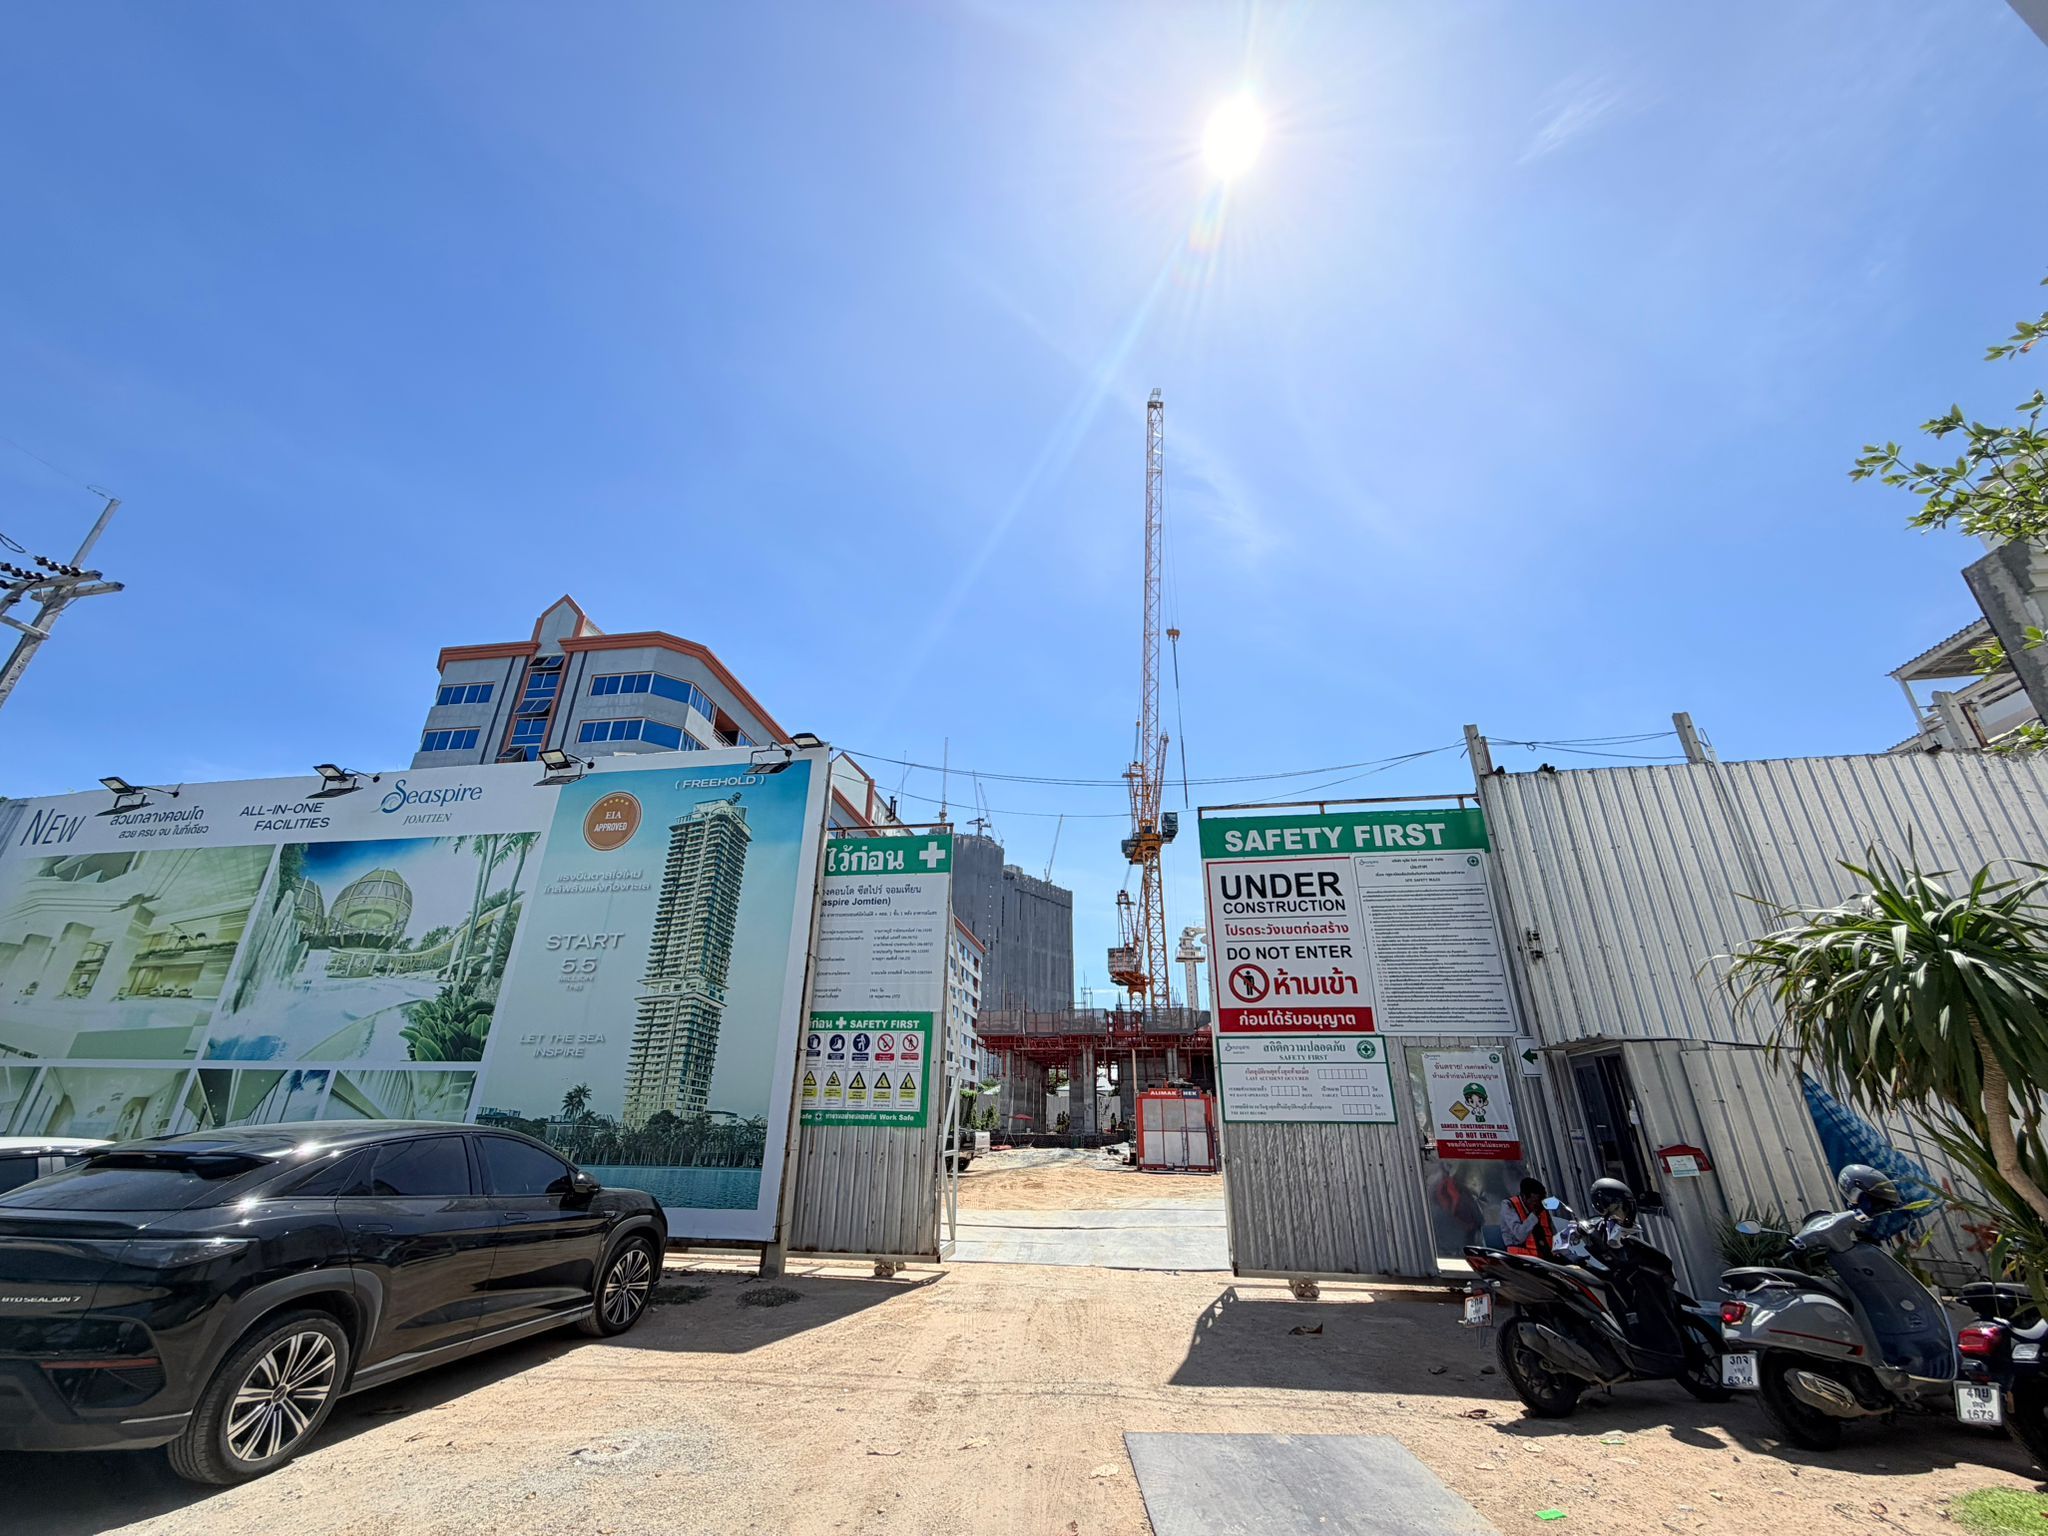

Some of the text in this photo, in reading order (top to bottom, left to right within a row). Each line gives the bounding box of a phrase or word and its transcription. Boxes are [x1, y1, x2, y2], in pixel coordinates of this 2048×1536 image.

[682, 776, 756, 789] FREEHOLD
[380, 779, 483, 814] Seaspire
[110, 806, 205, 826] สวนกลางคอนโด
[239, 802, 325, 817] ALL-IN-ONE
[605, 811, 621, 819] EIA
[254, 817, 330, 832] FACILITIES
[402, 813, 453, 826] JOMTIEN
[594, 822, 627, 832] APPROVED
[20, 809, 87, 846] NEW
[1225, 823, 1446, 852] SAFETY FIRST
[827, 844, 905, 872] ไว้ก่อน
[1220, 871, 1344, 900] UNDER
[852, 897, 891, 906] Jomtien)
[1223, 899, 1346, 914] CONSTRUCTION
[1225, 921, 1349, 936] โปรดระวังเขตก่อสร้าง
[545, 932, 626, 950] START
[1227, 945, 1353, 960] DO NOT ENTER
[561, 957, 598, 974] 5.5
[1274, 966, 1358, 995] ห้ามเข้า
[850, 1020, 888, 1029] SAFETY
[891, 1020, 920, 1029] FIRST
[1239, 1010, 1356, 1029] ก่อนได้รับอนุญาต
[520, 1032, 606, 1045] LET THE SEA
[533, 1047, 585, 1058] INSPIRE
[1967, 1409, 1994, 1420] 1679
